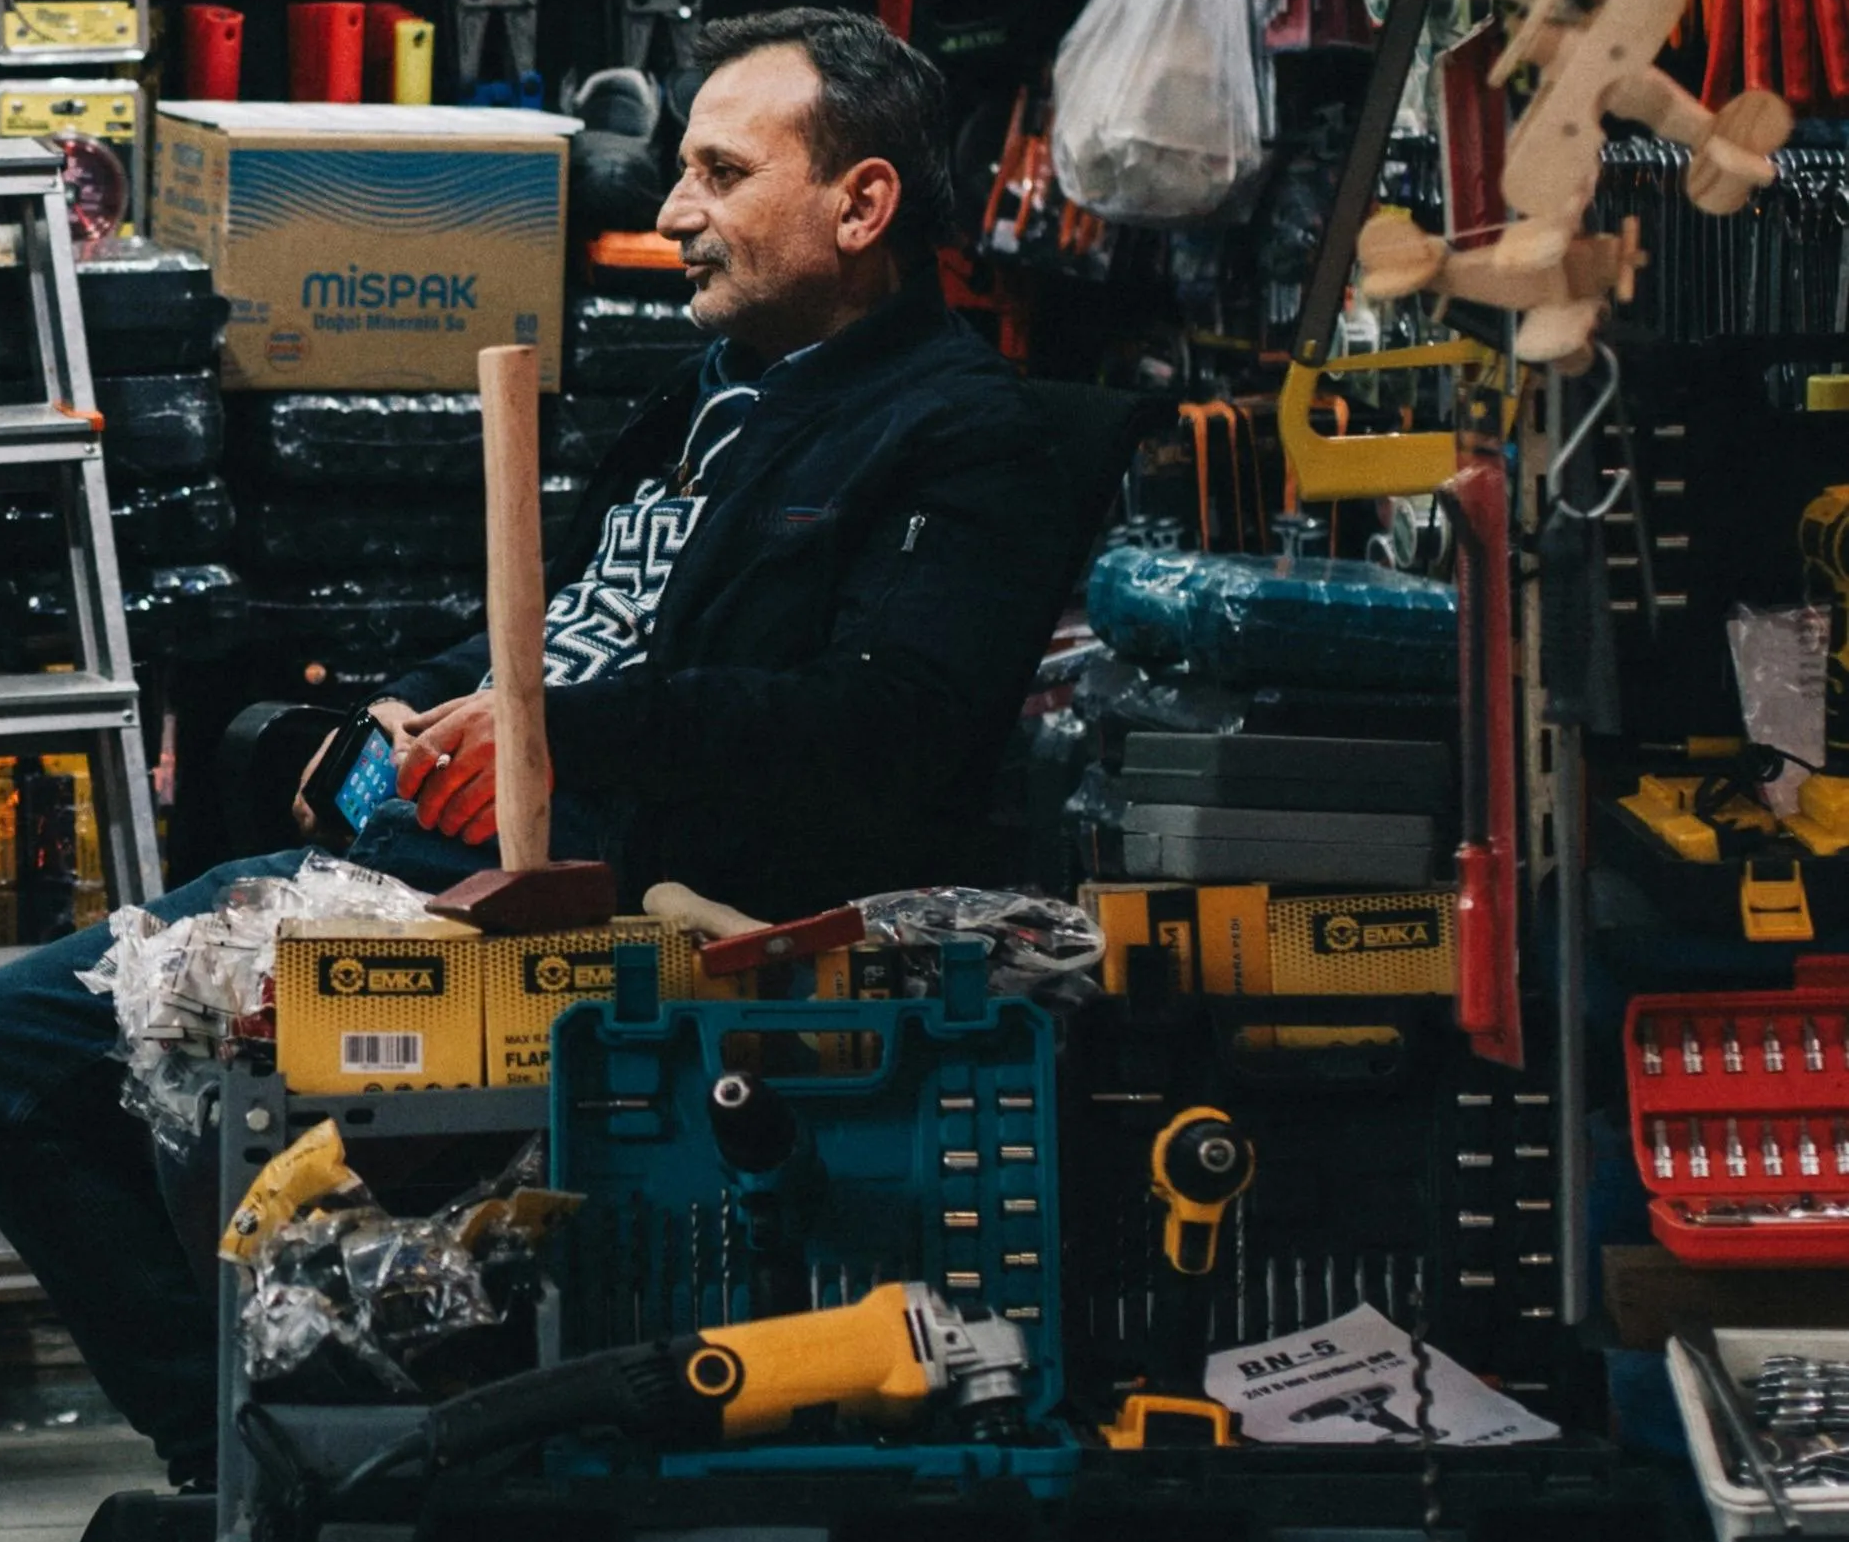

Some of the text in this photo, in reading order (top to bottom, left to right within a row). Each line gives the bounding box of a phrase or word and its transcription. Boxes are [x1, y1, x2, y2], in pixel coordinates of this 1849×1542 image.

[1363, 922, 1430, 948] EMKA
[368, 969, 434, 992] EMKA
[574, 965, 616, 988] EMK
[1237, 1339, 1338, 1378] BN-5
